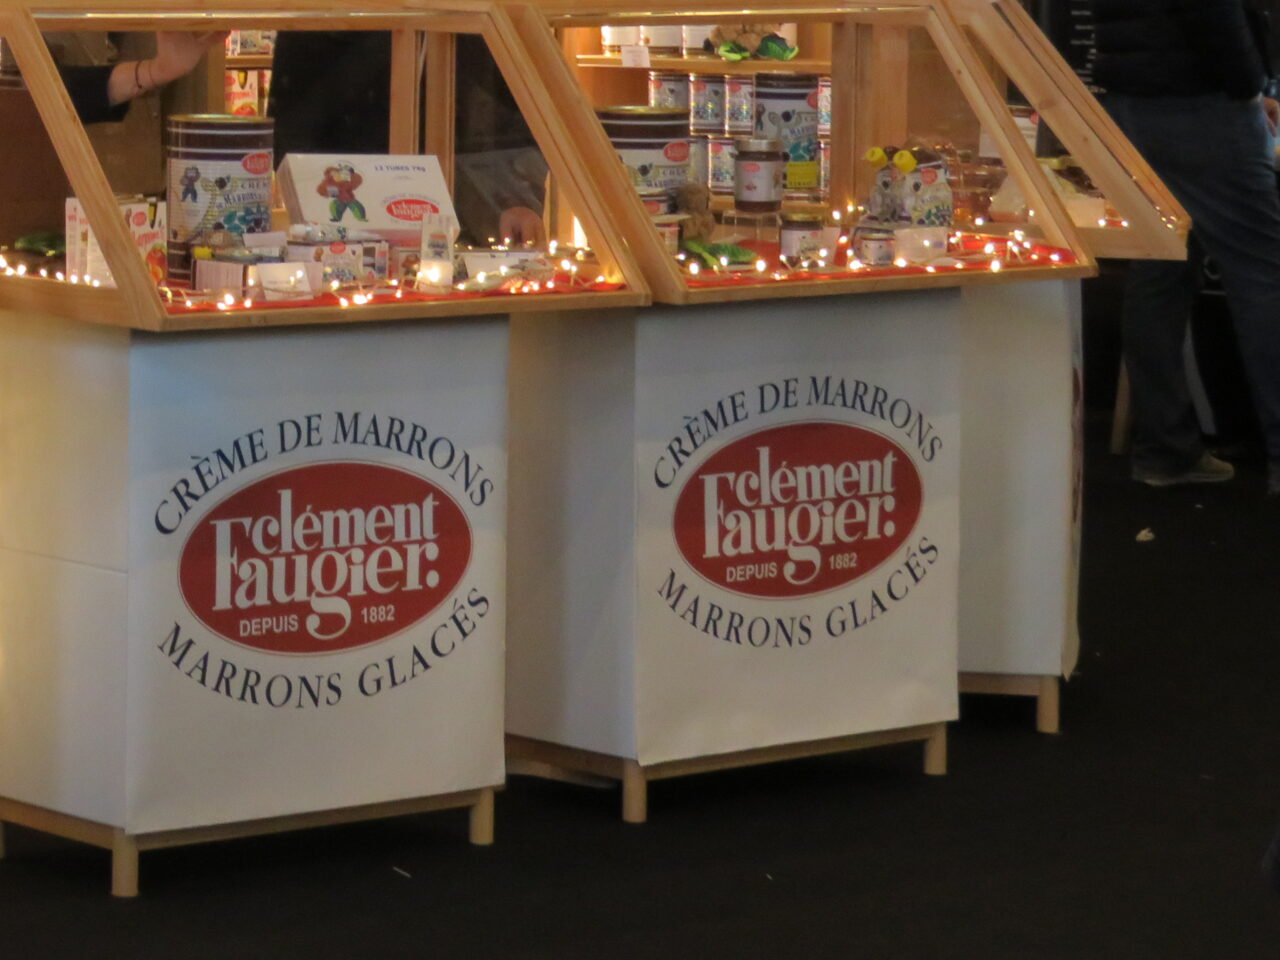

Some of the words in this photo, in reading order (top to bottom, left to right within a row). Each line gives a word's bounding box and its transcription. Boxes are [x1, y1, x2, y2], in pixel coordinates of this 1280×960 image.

[154, 428, 269, 536] CRÈME
[277, 413, 324, 456] DE
[332, 411, 495, 507] MARRONS
[654, 390, 749, 490] CRÈME
[757, 377, 799, 416] DE
[806, 375, 944, 464] MARRONS
[735, 445, 898, 507] clément
[252, 489, 440, 555] clément
[657, 567, 813, 649] MARRONS
[825, 536, 940, 638] GLACÉS
[726, 562, 777, 583] DEPUIS
[828, 552, 858, 571] 1882
[157, 621, 342, 710] MARRONS
[357, 587, 491, 698] GLACÉS
[239, 614, 299, 637] DEPUIS
[360, 604, 396, 624] 1882
